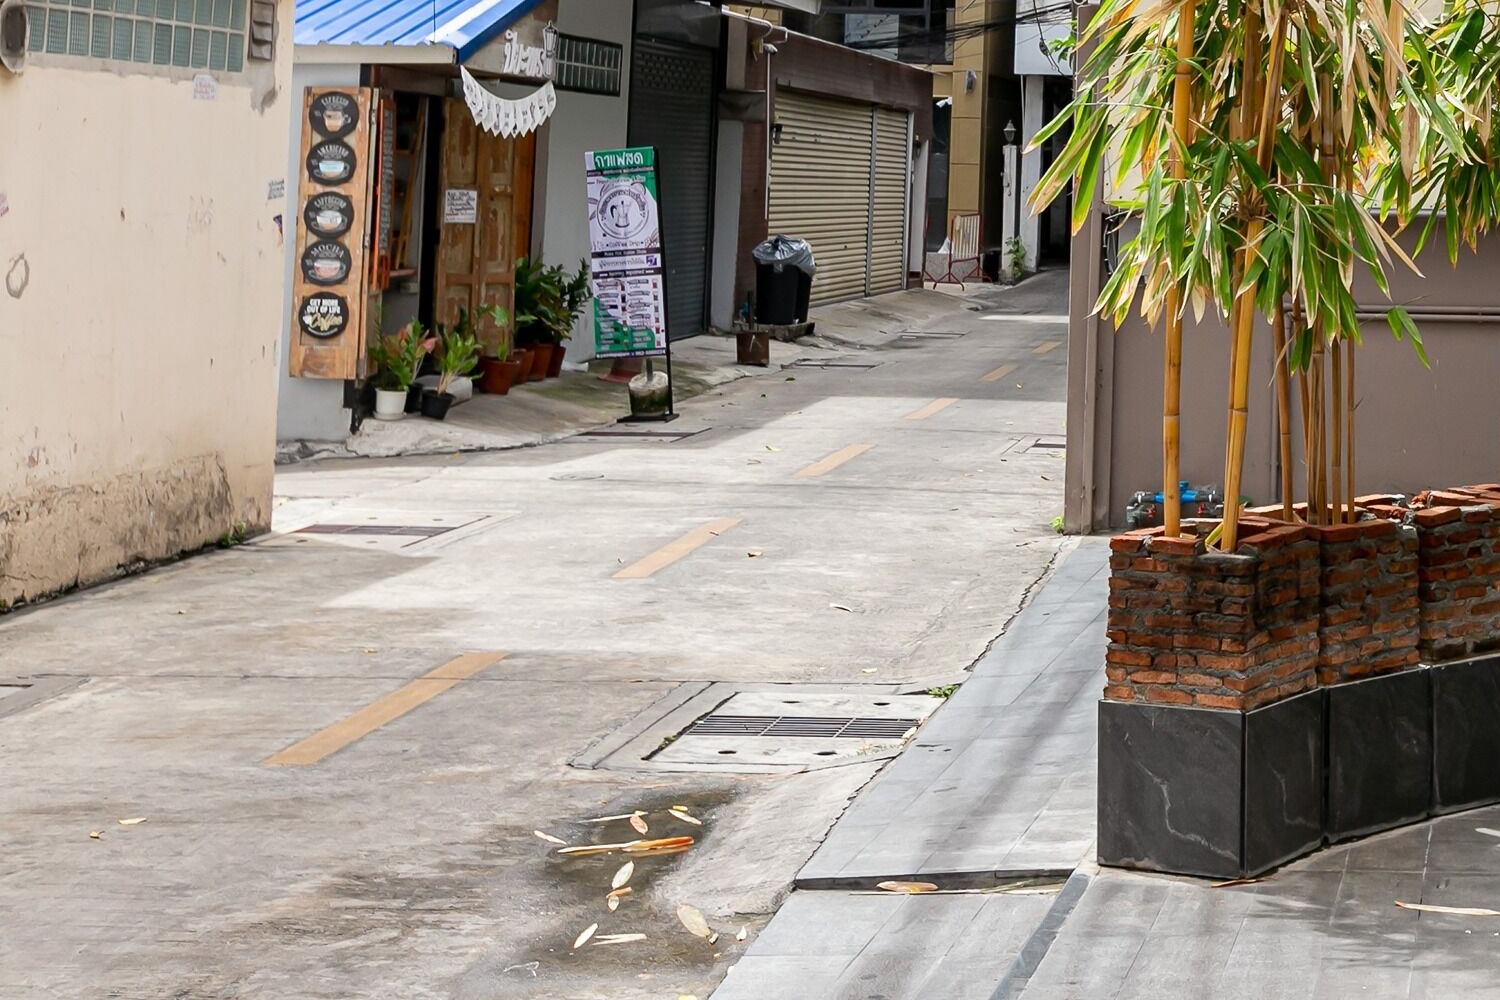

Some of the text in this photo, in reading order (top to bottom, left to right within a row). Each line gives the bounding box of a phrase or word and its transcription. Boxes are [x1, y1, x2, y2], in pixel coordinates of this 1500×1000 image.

[595, 151, 644, 168] กาแฟสด
[310, 243, 345, 259] MOCHA
